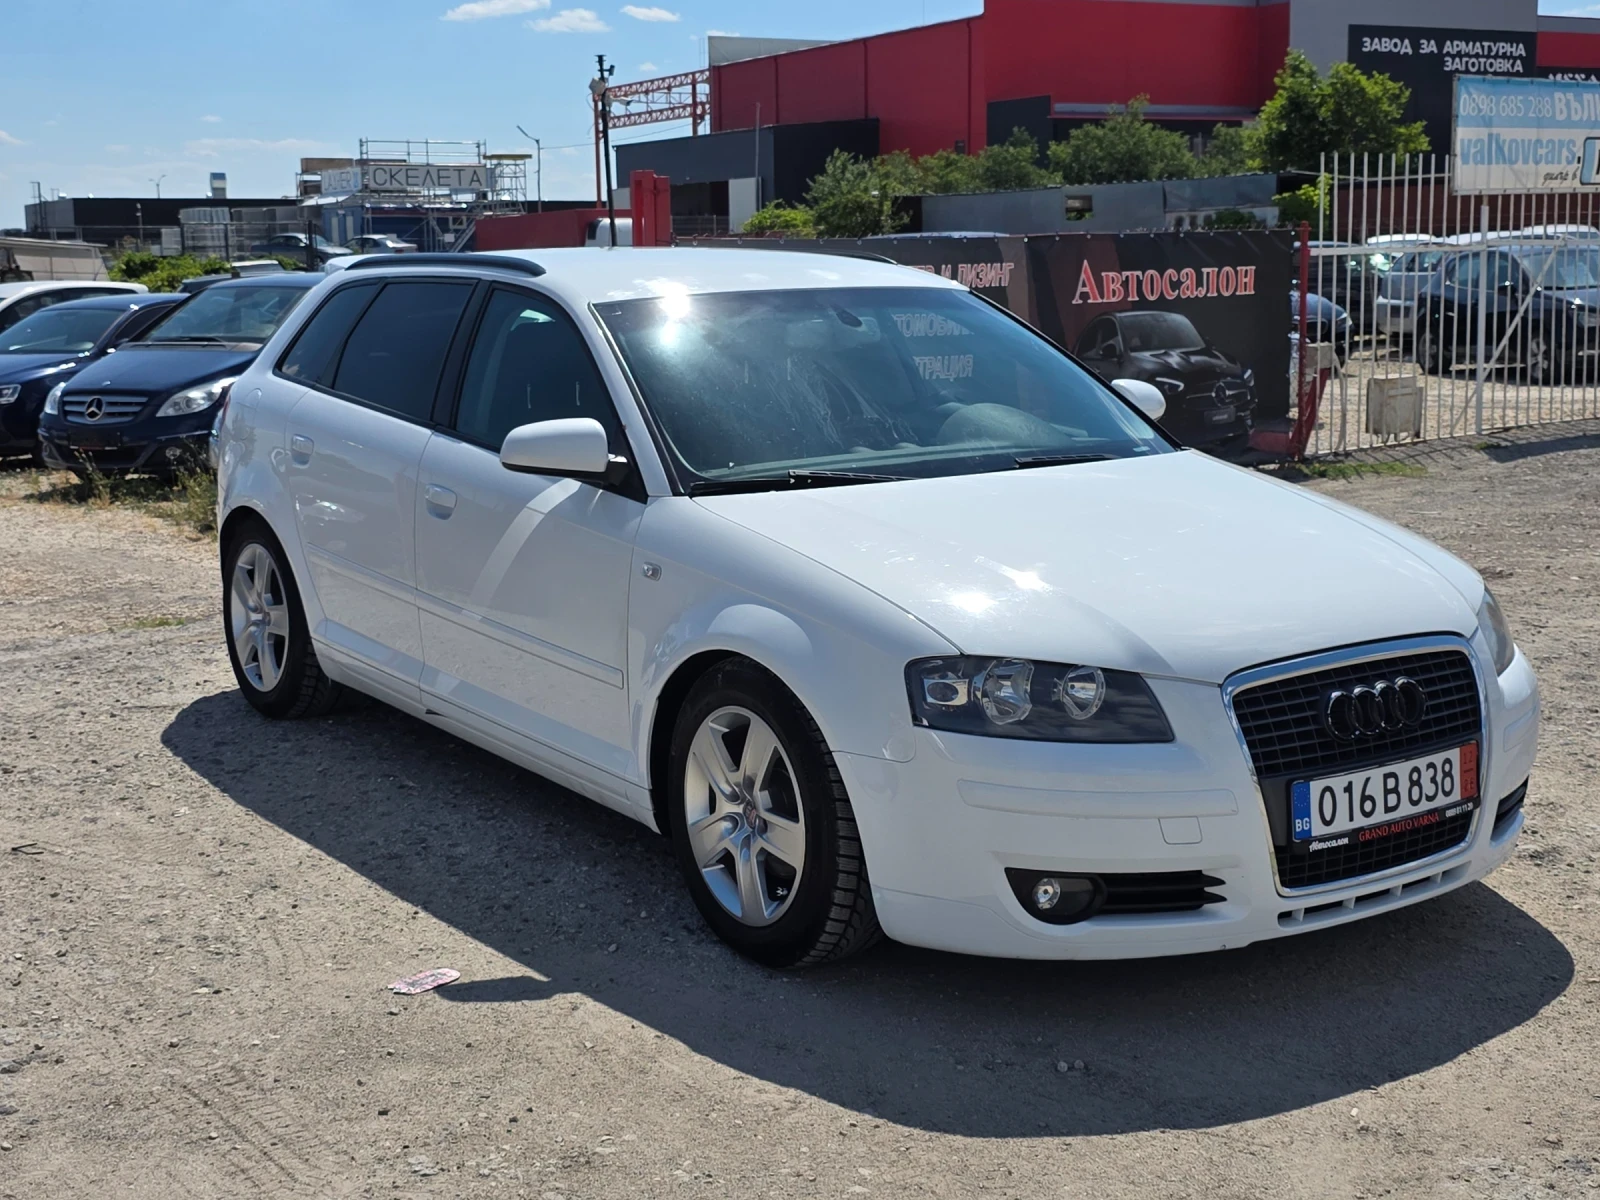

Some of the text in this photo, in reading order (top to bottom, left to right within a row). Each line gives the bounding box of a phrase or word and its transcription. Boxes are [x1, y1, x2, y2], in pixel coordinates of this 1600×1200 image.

[1362, 37, 1526, 57] ЗАВОД ЗА АРМАТУРНА
[1444, 57, 1523, 73] ЗАГОТОВКА
[1460, 91, 1600, 121] 0898 685 288 ВЪЛ
[1071, 258, 1257, 305] Автосалон
[1295, 817, 1310, 832] BG
[1358, 812, 1440, 842] GRAND AUTO VARNA
